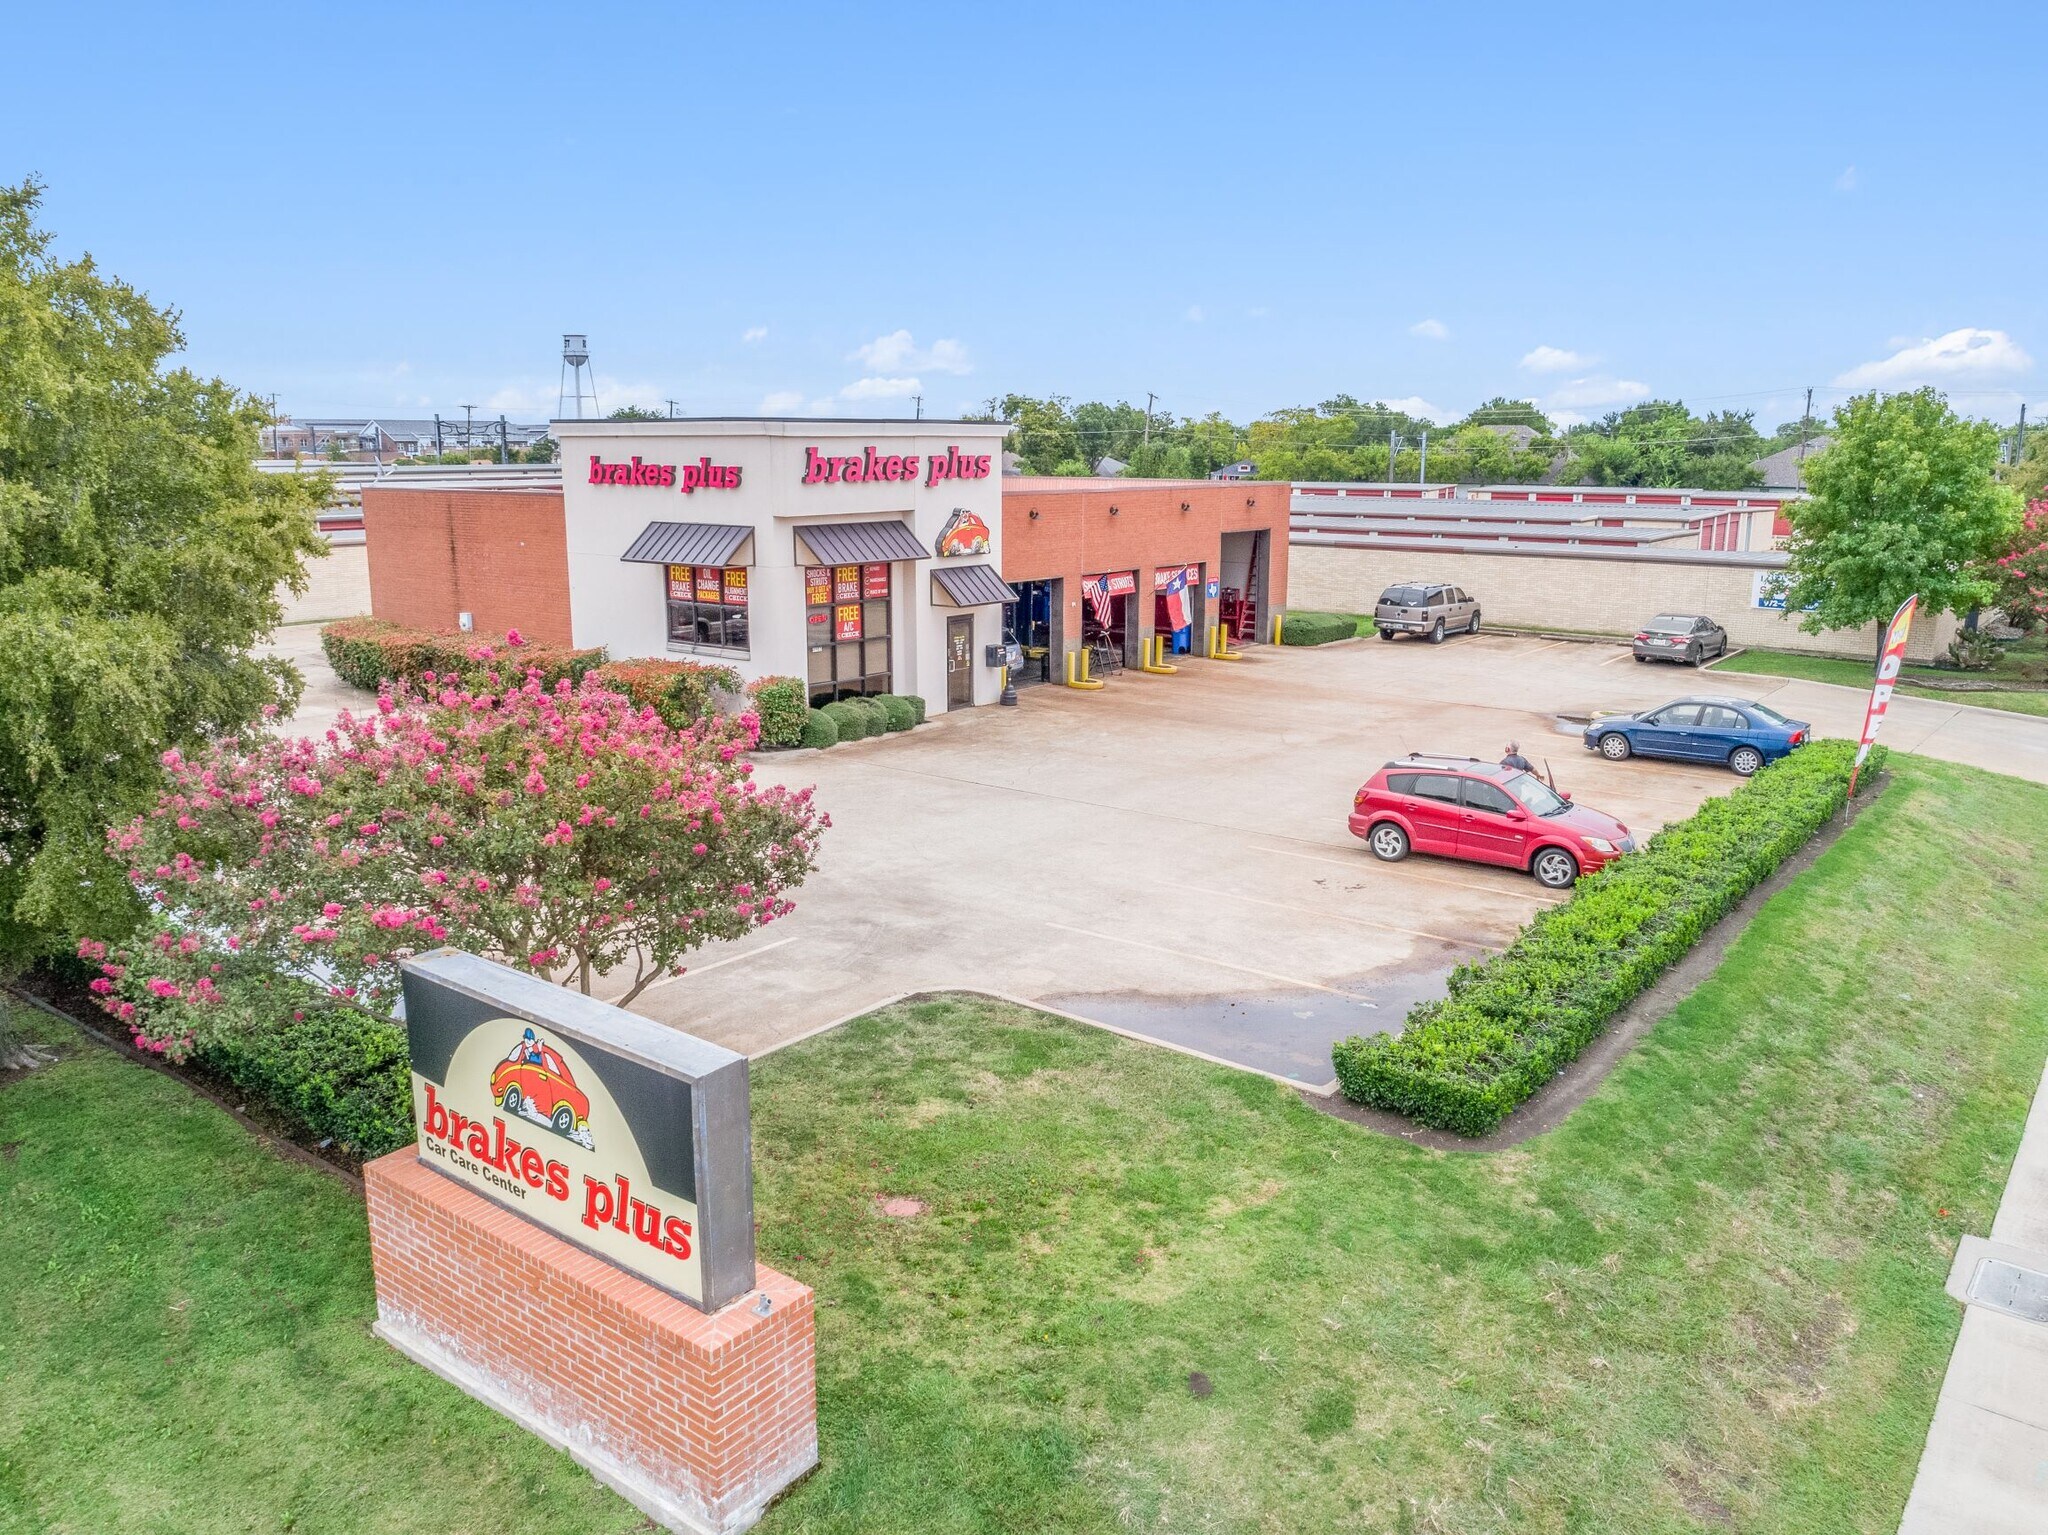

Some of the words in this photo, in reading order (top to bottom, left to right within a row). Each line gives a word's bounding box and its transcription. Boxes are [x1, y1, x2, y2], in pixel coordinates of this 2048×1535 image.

[802, 446, 920, 485] brakes
[924, 445, 992, 488] plus
[588, 455, 676, 487] brakes
[681, 457, 743, 494] plus
[670, 565, 690, 581] FREE
[703, 569, 712, 579] OIL
[725, 571, 746, 587] FREE
[806, 569, 826, 578] SHOCKS
[837, 567, 858, 582] FREE
[672, 581, 690, 591] BRAKE
[697, 579, 720, 591] CHANGE
[810, 577, 828, 586] STRUTS
[837, 582, 858, 593] BRAKE
[1111, 576, 1134, 590] STRUTS
[697, 590, 720, 600] PACKAGES
[811, 592, 828, 603] FREE
[808, 614, 828, 624] OPEN
[838, 605, 859, 622] FREE
[843, 622, 854, 632] A/C
[423, 1083, 570, 1202] brakes
[582, 1173, 692, 1261] plus
[426, 1136, 446, 1159] Car
[450, 1149, 479, 1176] Care
[482, 1166, 527, 1200] Center
